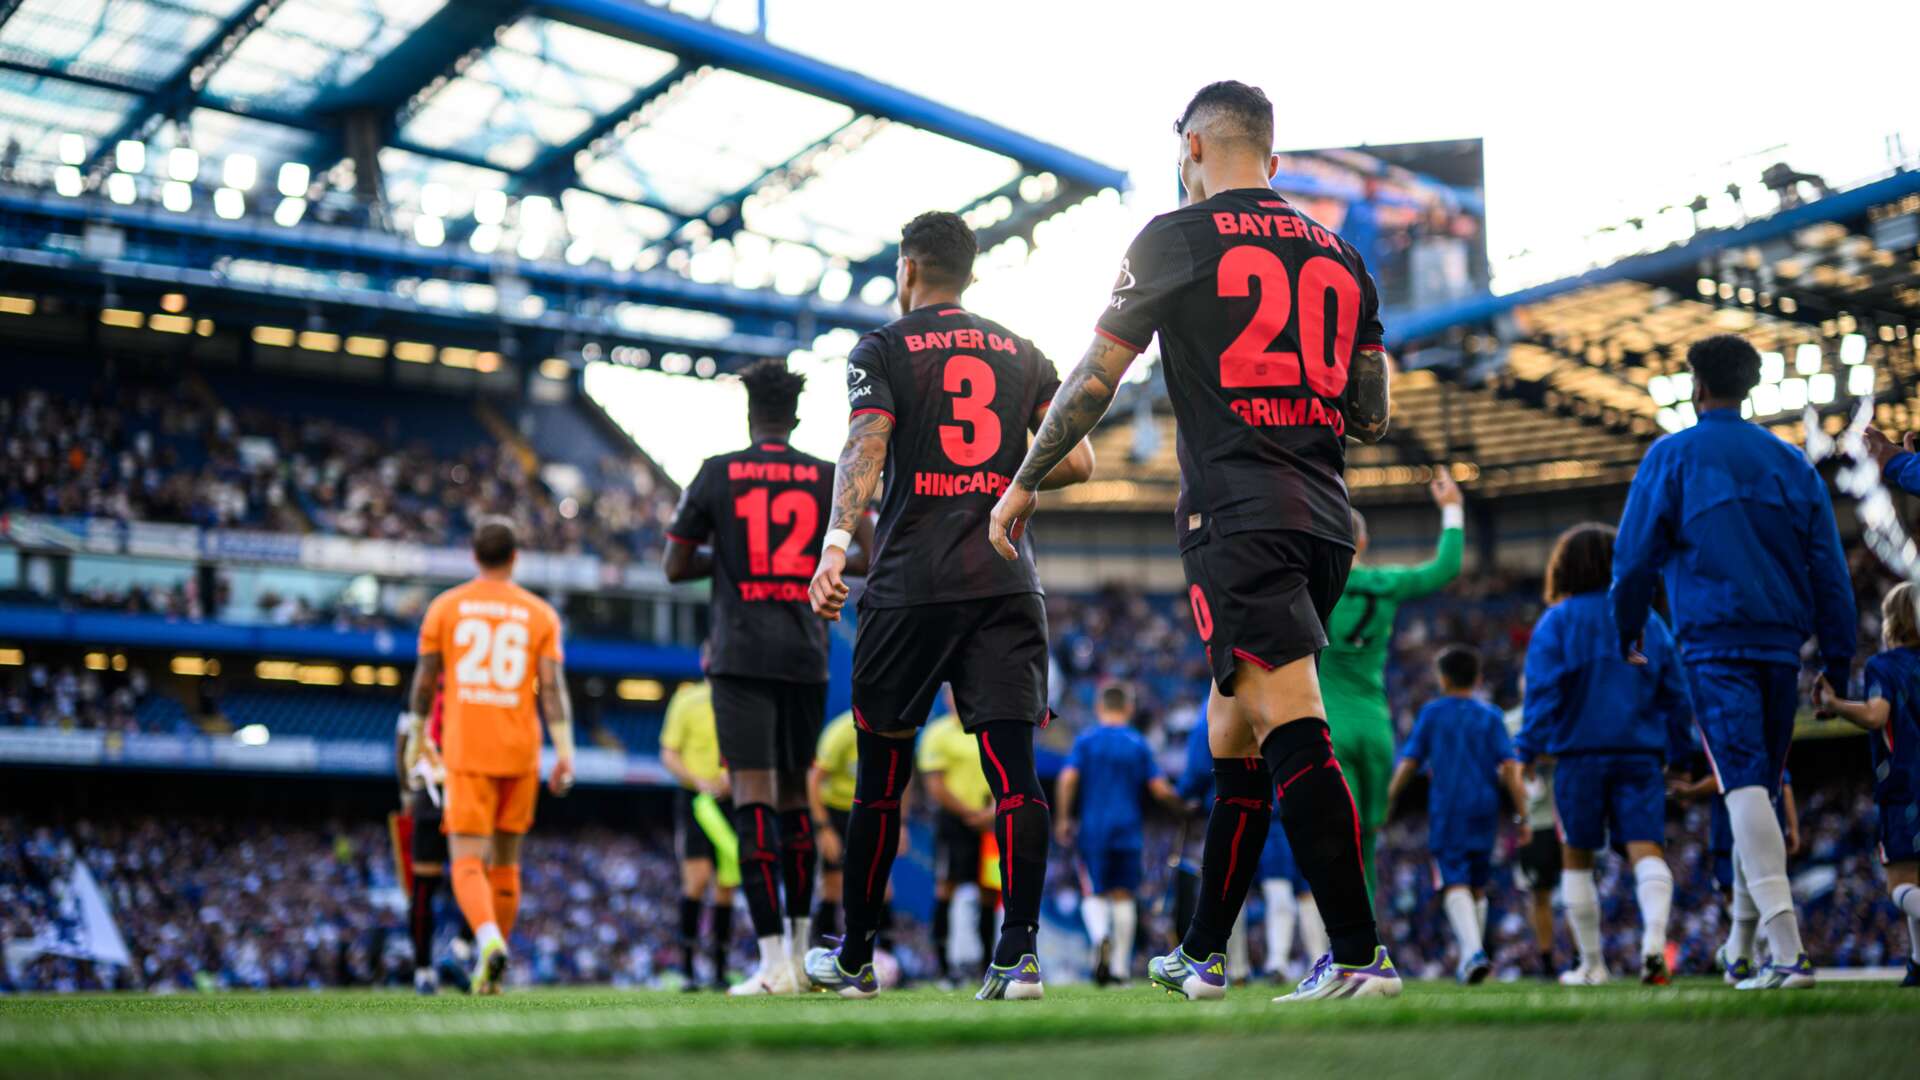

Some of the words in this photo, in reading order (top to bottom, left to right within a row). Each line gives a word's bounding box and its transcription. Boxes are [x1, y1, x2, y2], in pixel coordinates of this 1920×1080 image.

[1212, 211, 1312, 241] BAYER
[904, 329, 985, 352] BAYER
[988, 332, 1017, 355] 04
[1217, 244, 1361, 398] 20
[938, 354, 1002, 467] 3
[729, 461, 791, 482] BAYER
[793, 464, 819, 483] 04
[735, 487, 819, 577] 12
[455, 618, 528, 689] 26
